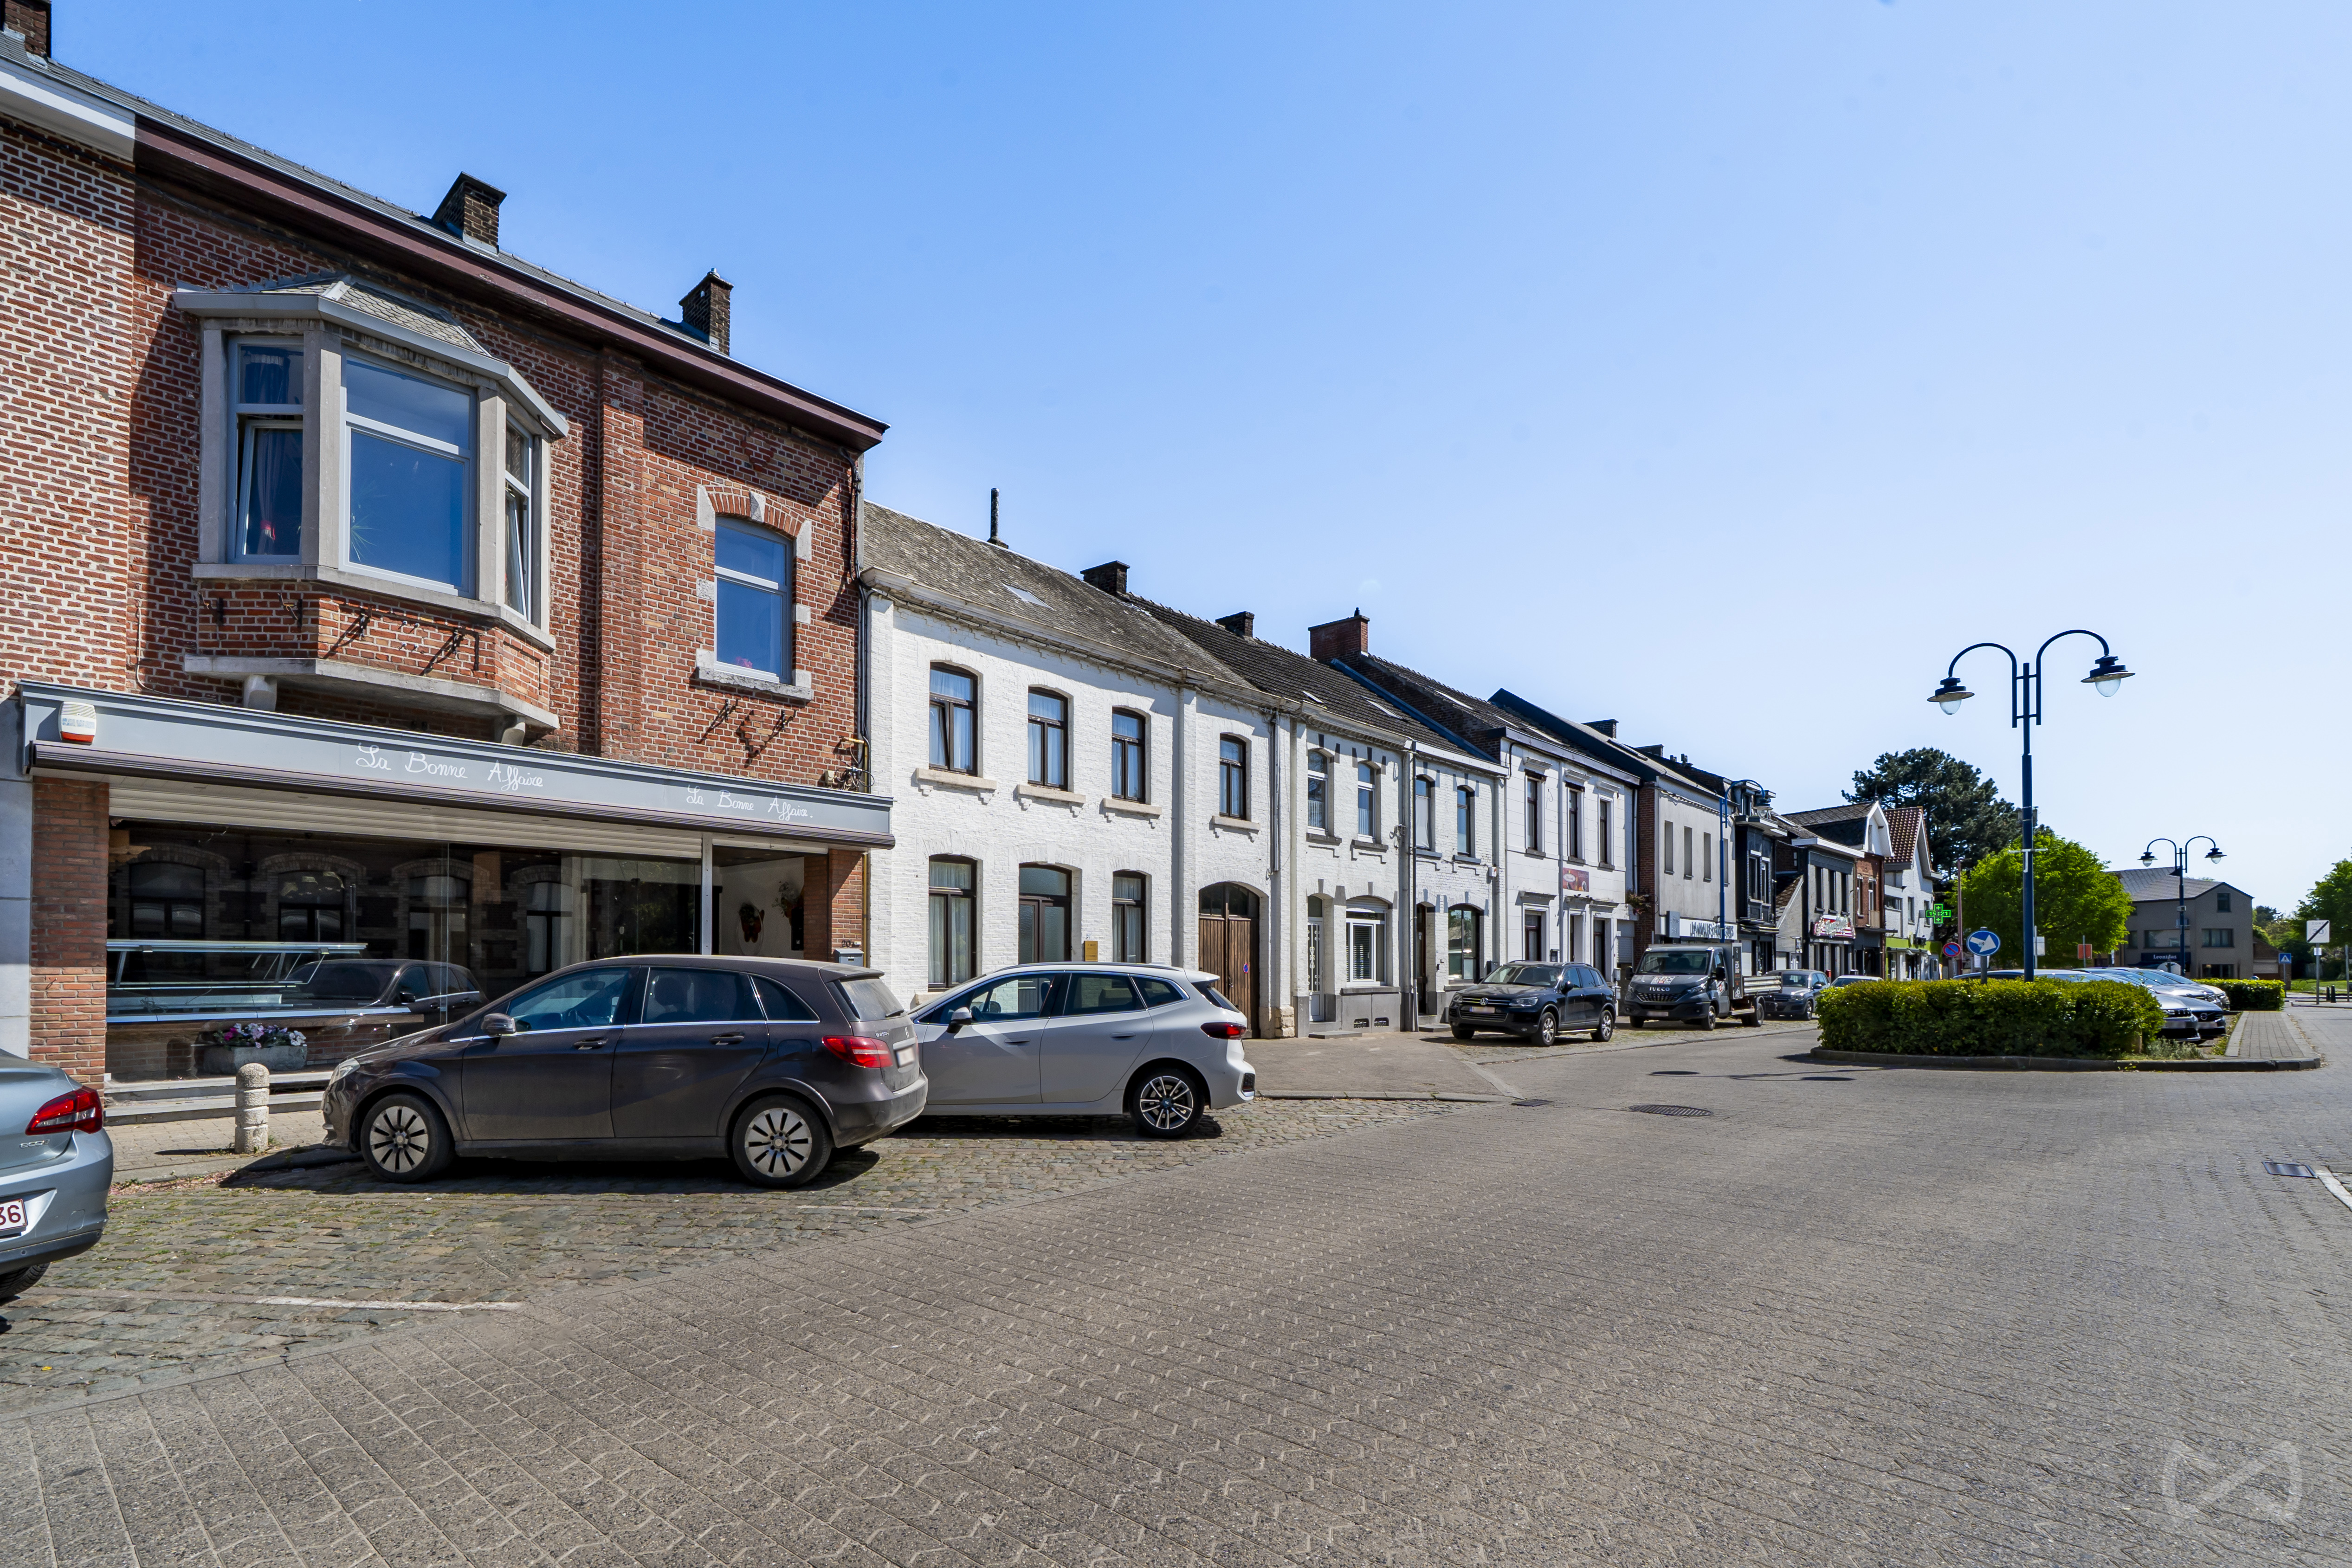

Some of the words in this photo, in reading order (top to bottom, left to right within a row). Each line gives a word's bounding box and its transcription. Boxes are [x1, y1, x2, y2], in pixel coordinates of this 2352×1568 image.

[355, 742, 391, 770] La
[405, 751, 468, 779] Bonne
[487, 760, 543, 791] Affaire
[686, 785, 704, 805] La
[717, 790, 754, 810] Bonne
